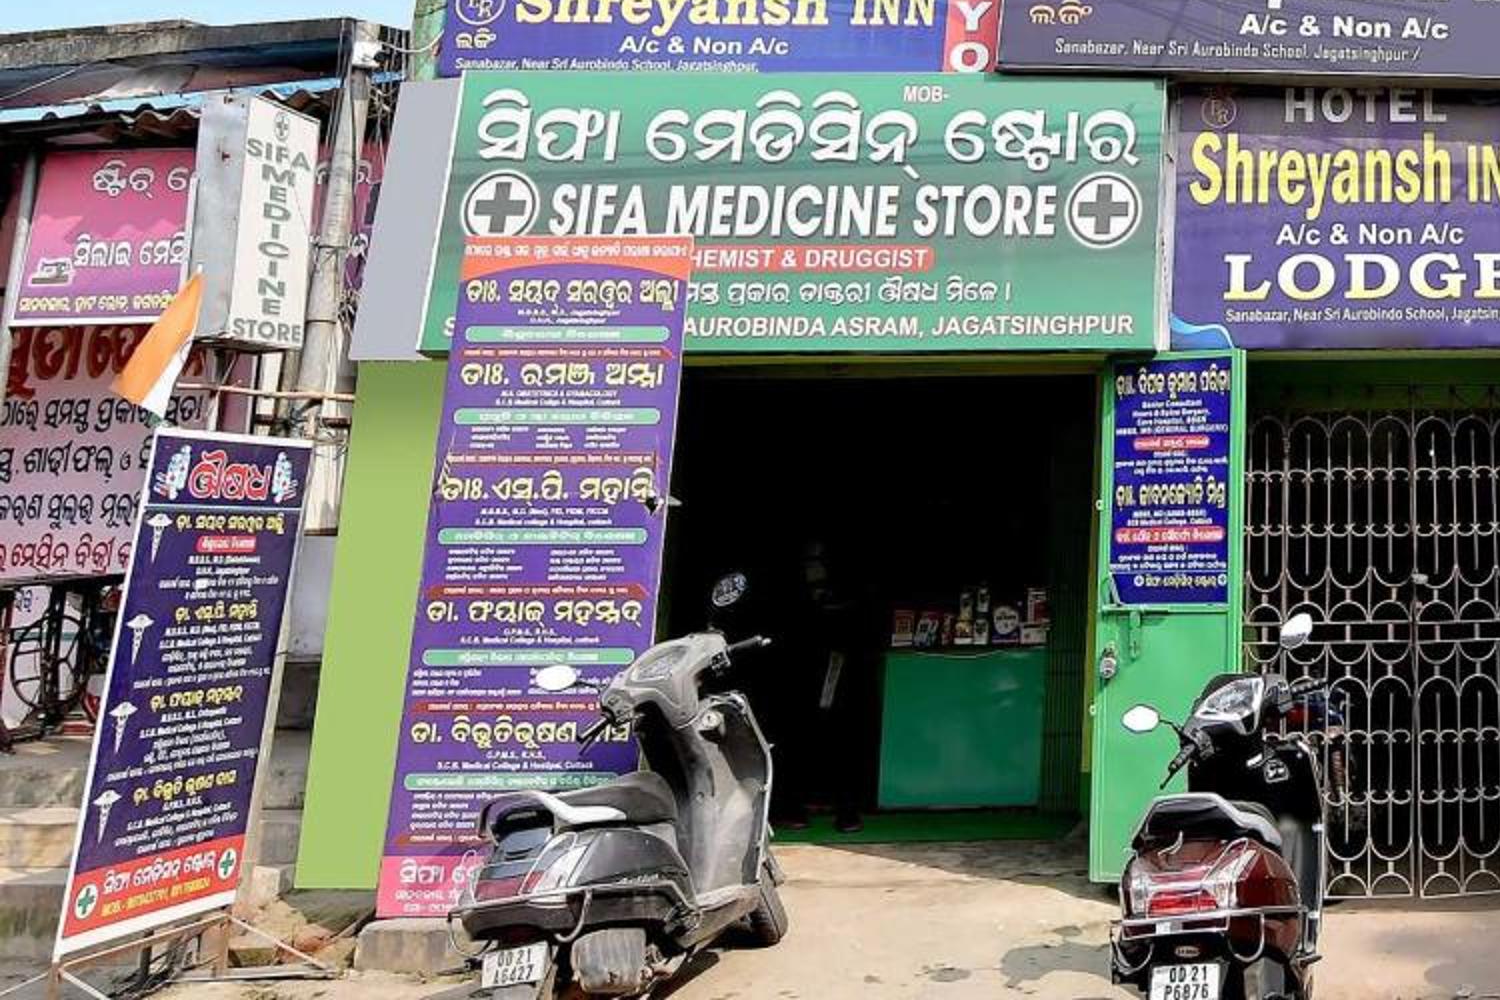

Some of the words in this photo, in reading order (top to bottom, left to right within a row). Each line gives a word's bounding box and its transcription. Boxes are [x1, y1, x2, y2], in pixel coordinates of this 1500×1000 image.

[1239, 13, 1287, 36] A/c
[1299, 14, 1321, 38] &
[1333, 15, 1392, 39] Non
[1401, 17, 1448, 41] A/c
[619, 36, 662, 55] A/c
[667, 37, 687, 55] &
[693, 37, 743, 55] Non
[748, 36, 789, 57] A/c
[1055, 38, 1129, 56] Sanabazar,
[1132, 40, 1164, 56] Near
[1168, 40, 1188, 57] Sri
[1192, 41, 1258, 58] Aurobindo
[521, 58, 549, 72] Near
[1284, 88, 1447, 123] HOTEL
[477, 89, 621, 163] ସିଫା
[248, 138, 311, 171] SIFA
[1189, 130, 1452, 220] Shreyansh
[549, 184, 649, 236] SIFA
[665, 184, 901, 237] MEDICINE
[913, 184, 1058, 237] STORE
[258, 163, 296, 315] MEDICINE
[1276, 223, 1320, 245] A/c
[1330, 224, 1349, 245] &
[1359, 223, 1412, 245] Non
[1420, 222, 1464, 245] A/c
[688, 249, 776, 270] HEMIST
[780, 250, 796, 269] &
[804, 248, 929, 269] DRUGGIST
[687, 282, 719, 305] ମସ୍ତ
[728, 282, 791, 307] ପ୍ରକାର
[878, 276, 939, 303] ଔଷଧ
[684, 316, 827, 338] AUROBINDA
[832, 316, 923, 338] ASRAM,
[931, 315, 1135, 336] JAGATSINGHPUR
[1225, 308, 1291, 325] Sanabazar,
[1293, 308, 1321, 322] Near
[1324, 308, 1341, 322] Sri
[1343, 307, 1402, 322] Aurobindo
[233, 317, 302, 344] STORE
